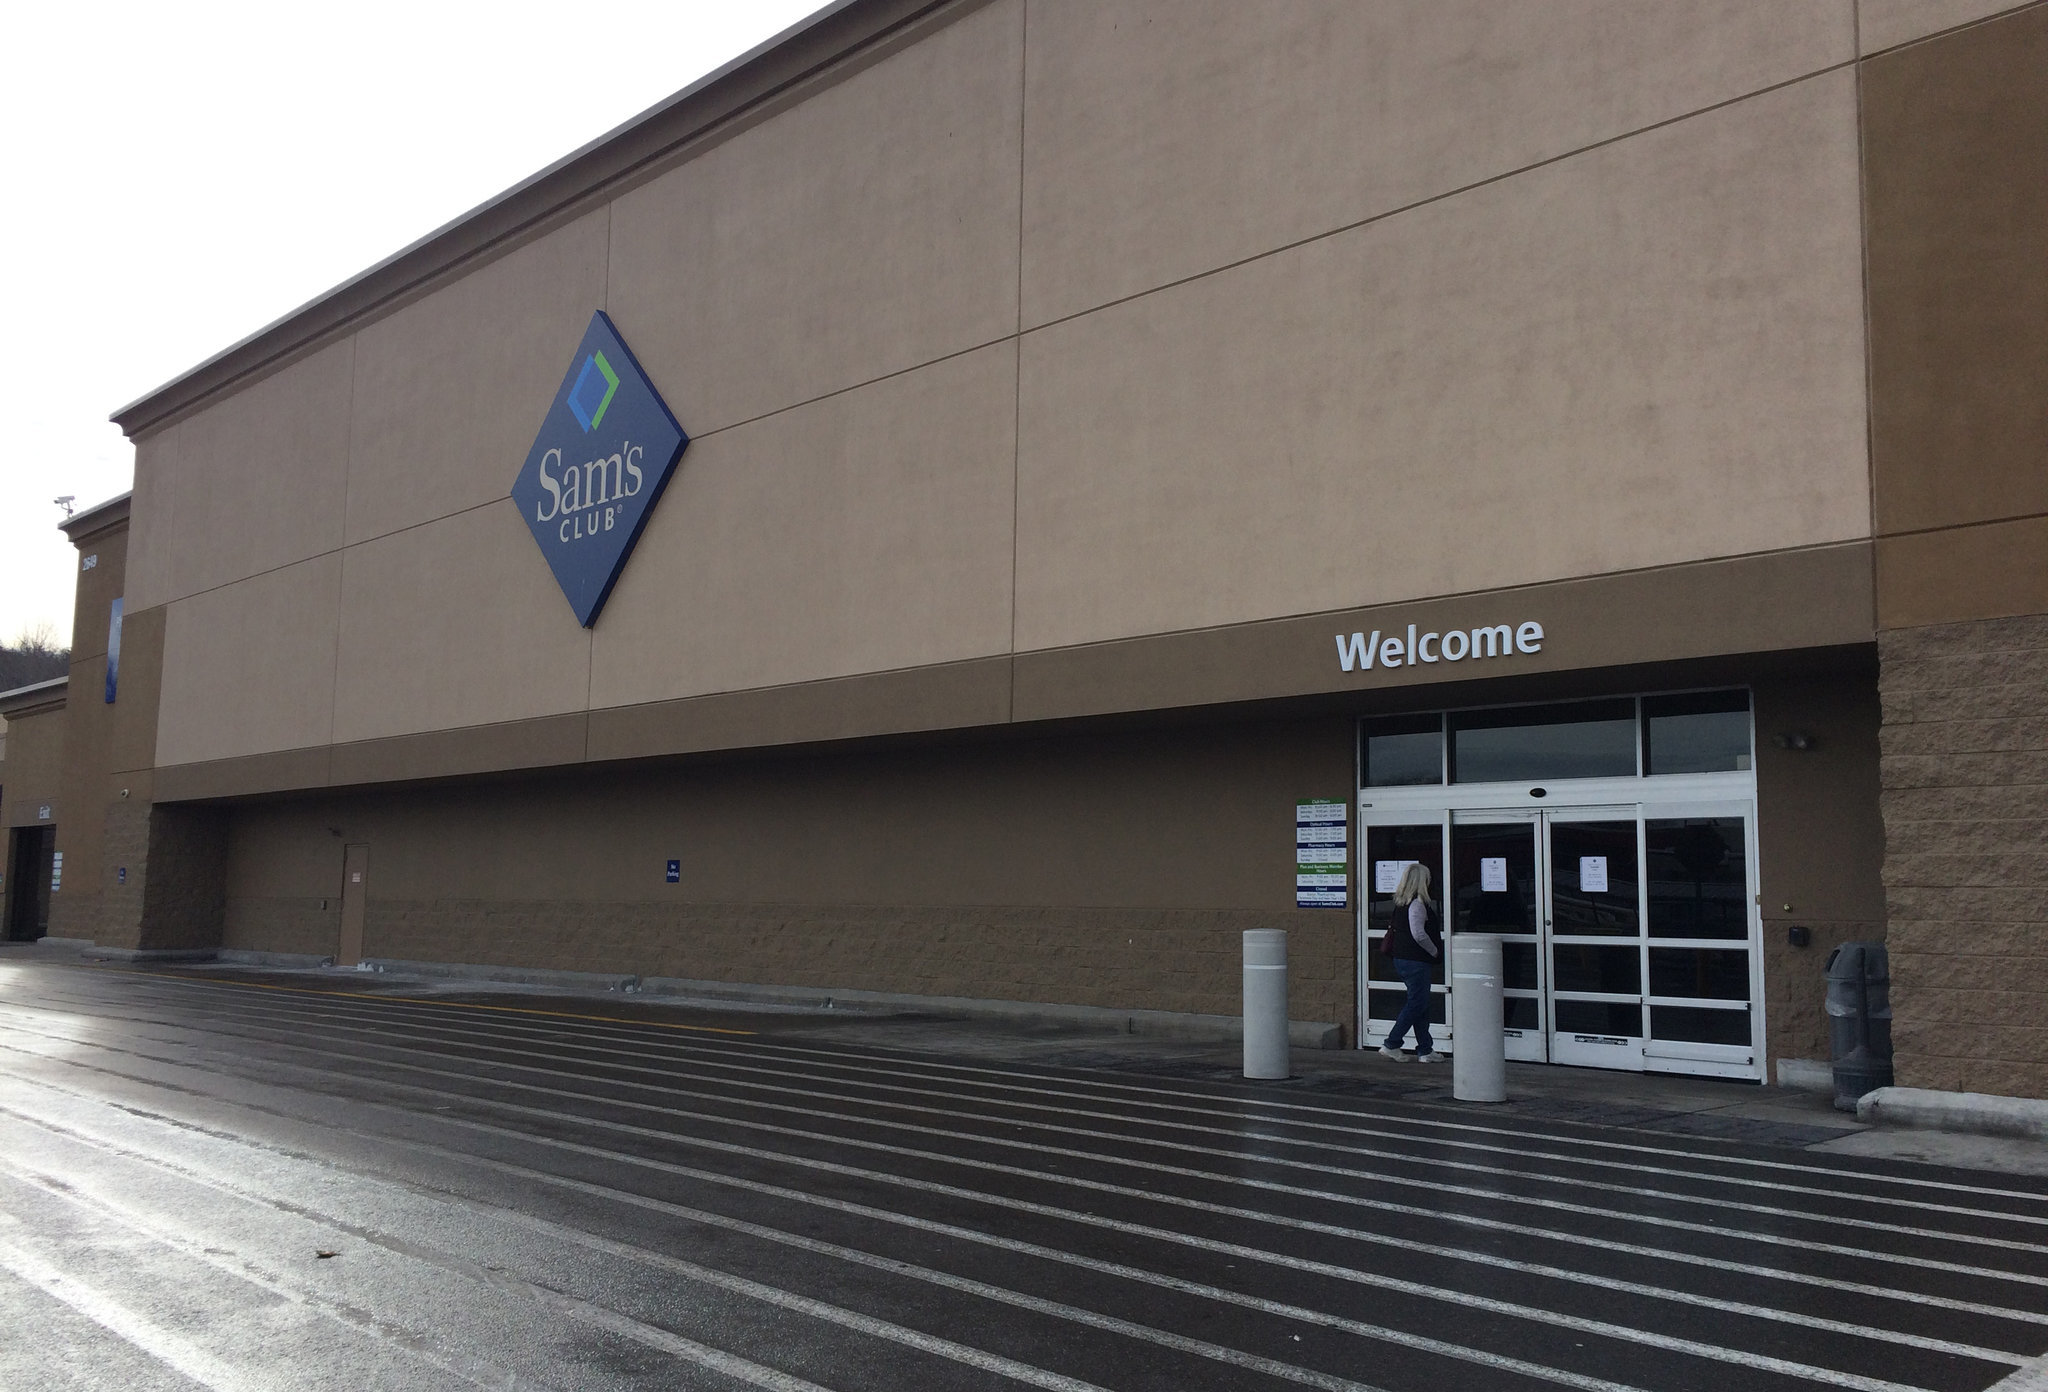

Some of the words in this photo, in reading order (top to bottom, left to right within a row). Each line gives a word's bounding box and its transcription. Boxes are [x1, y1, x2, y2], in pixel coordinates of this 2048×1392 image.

[537, 441, 643, 522] Sam's
[559, 508, 616, 543] CLUB
[1335, 620, 1545, 672] Welcome
